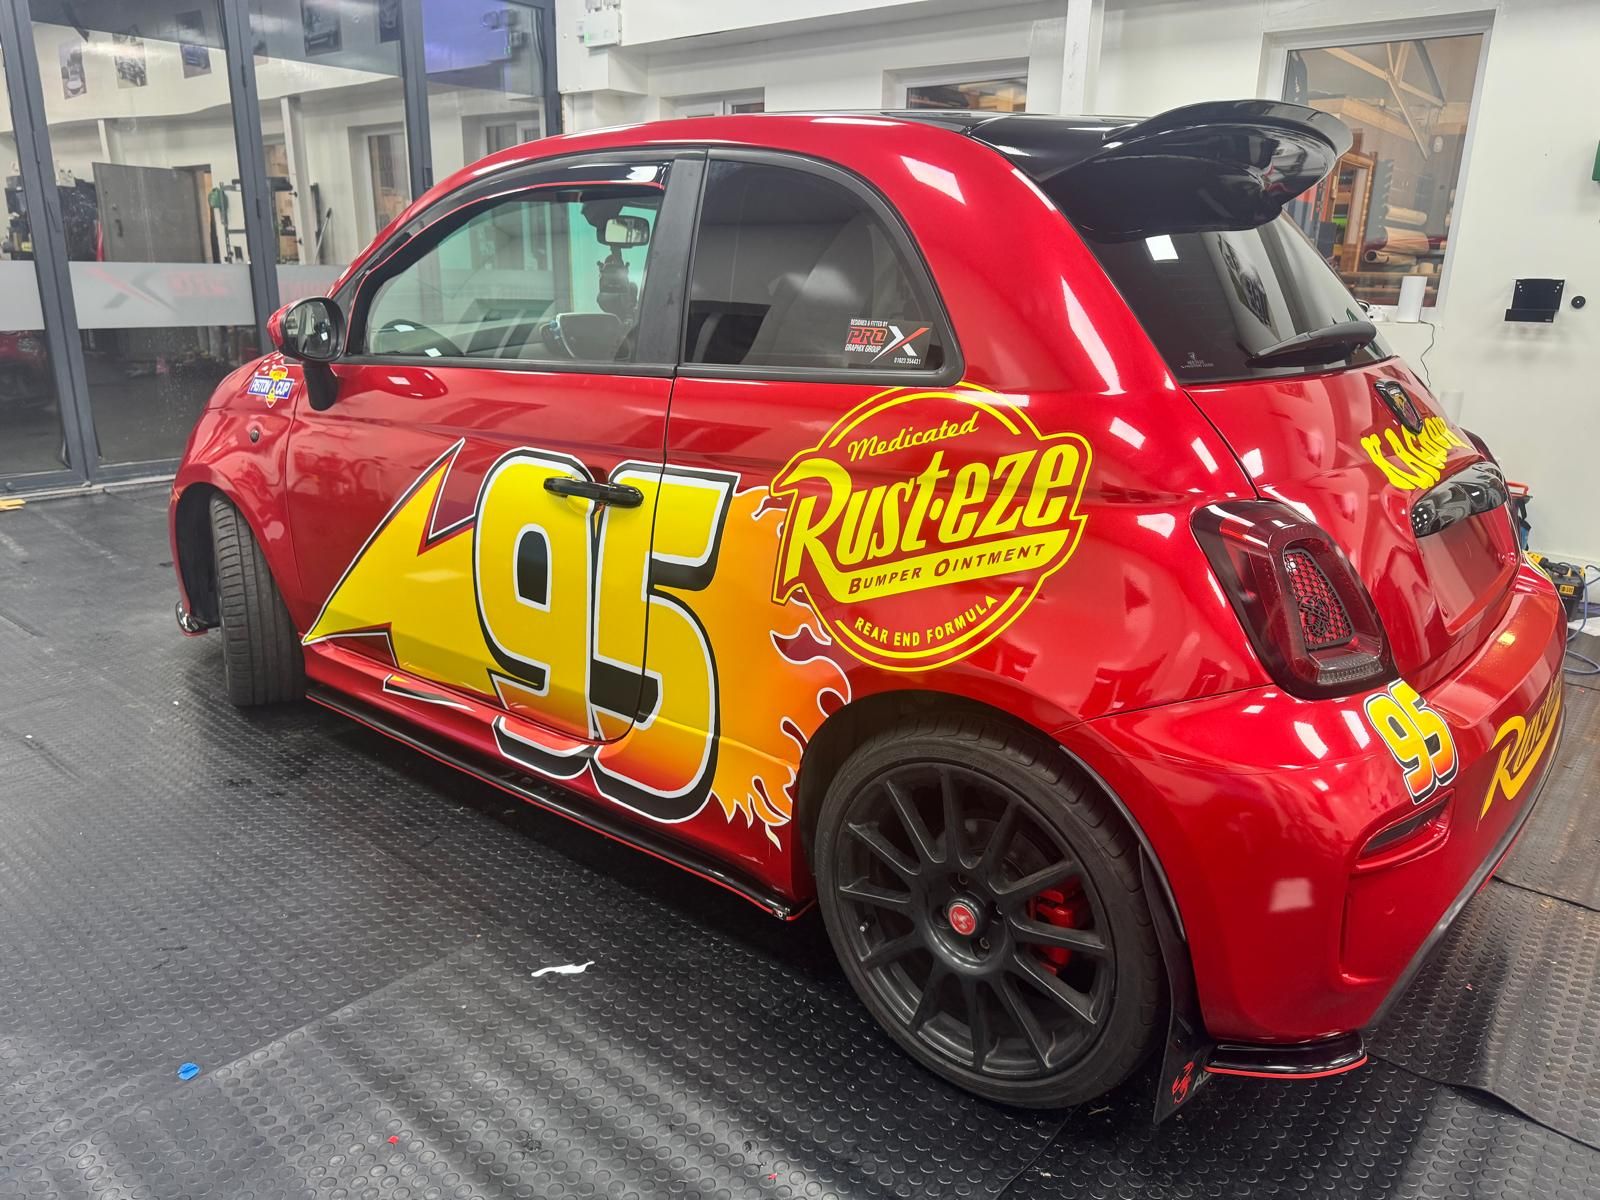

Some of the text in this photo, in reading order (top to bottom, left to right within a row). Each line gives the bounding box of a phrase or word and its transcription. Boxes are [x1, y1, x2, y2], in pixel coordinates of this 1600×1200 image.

[845, 343, 882, 353] GRAPHIX GROUP
[847, 326, 888, 345] PRO
[275, 380, 291, 397] CUP
[847, 411, 979, 462] Medicated
[847, 543, 1047, 595] BUMPER OINTMENT
[472, 446, 741, 824] 95
[854, 595, 999, 647] REAR END FORMULA
[1364, 678, 1459, 806] 95
